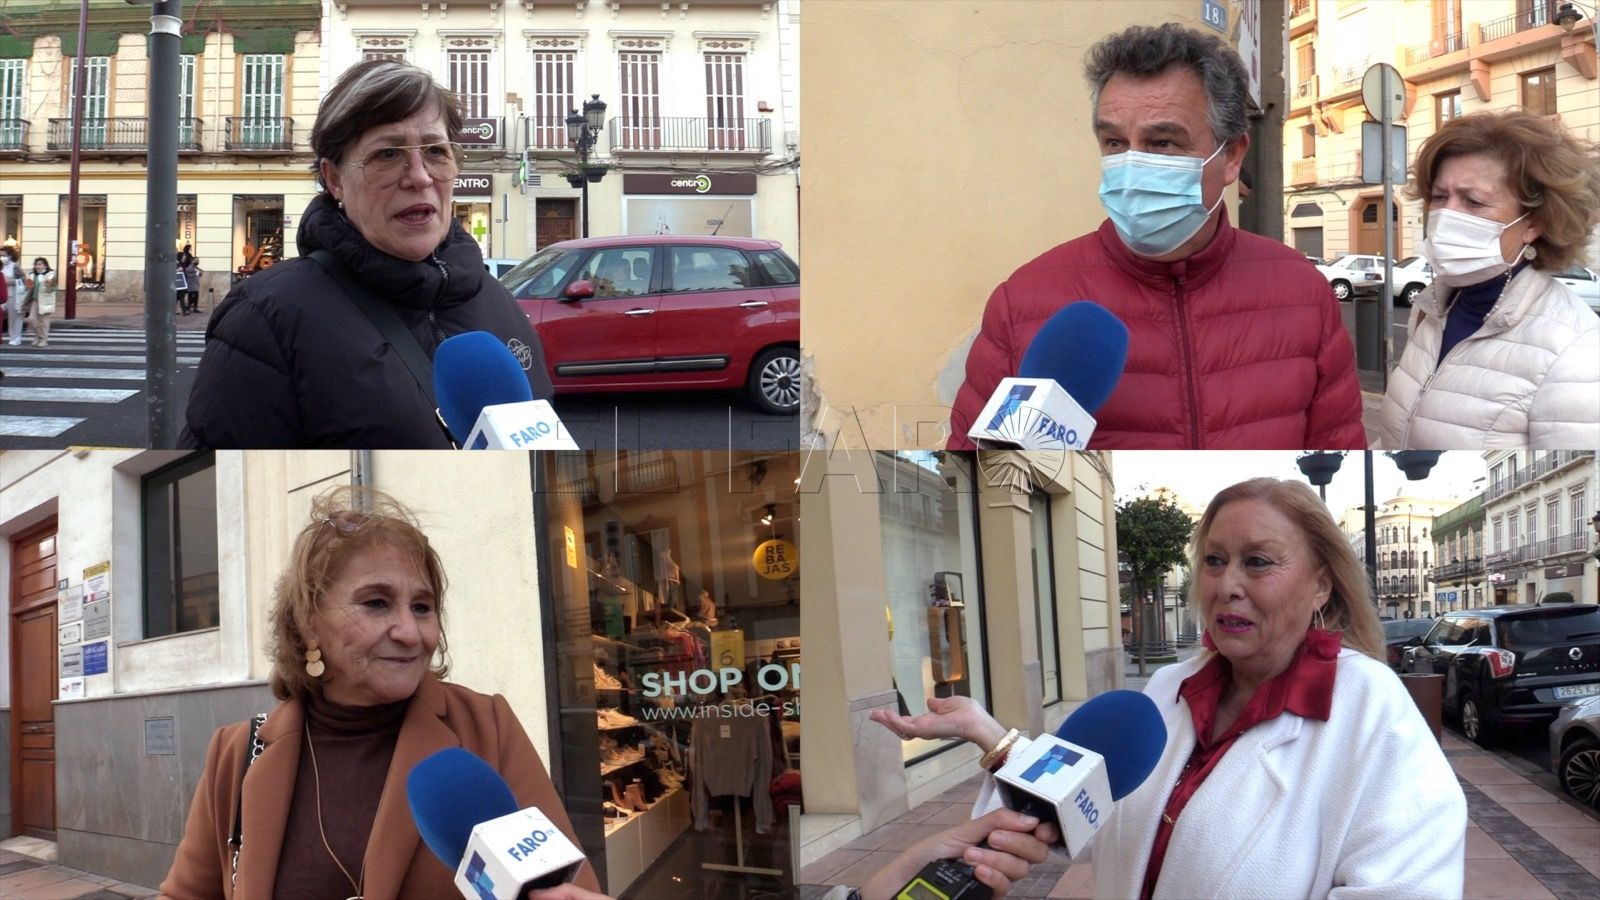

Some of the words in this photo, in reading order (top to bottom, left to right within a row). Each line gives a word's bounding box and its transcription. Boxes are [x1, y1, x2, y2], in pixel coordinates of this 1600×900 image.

[1204, 3, 1219, 24] 18
[509, 421, 551, 447] FARO
[1038, 417, 1078, 445] FARO
[765, 544, 784, 555] RE
[766, 554, 785, 564] BA
[763, 563, 791, 574] JAS
[642, 667, 743, 697] SHOP
[1074, 787, 1099, 825] FARO
[507, 829, 548, 862] FARO
